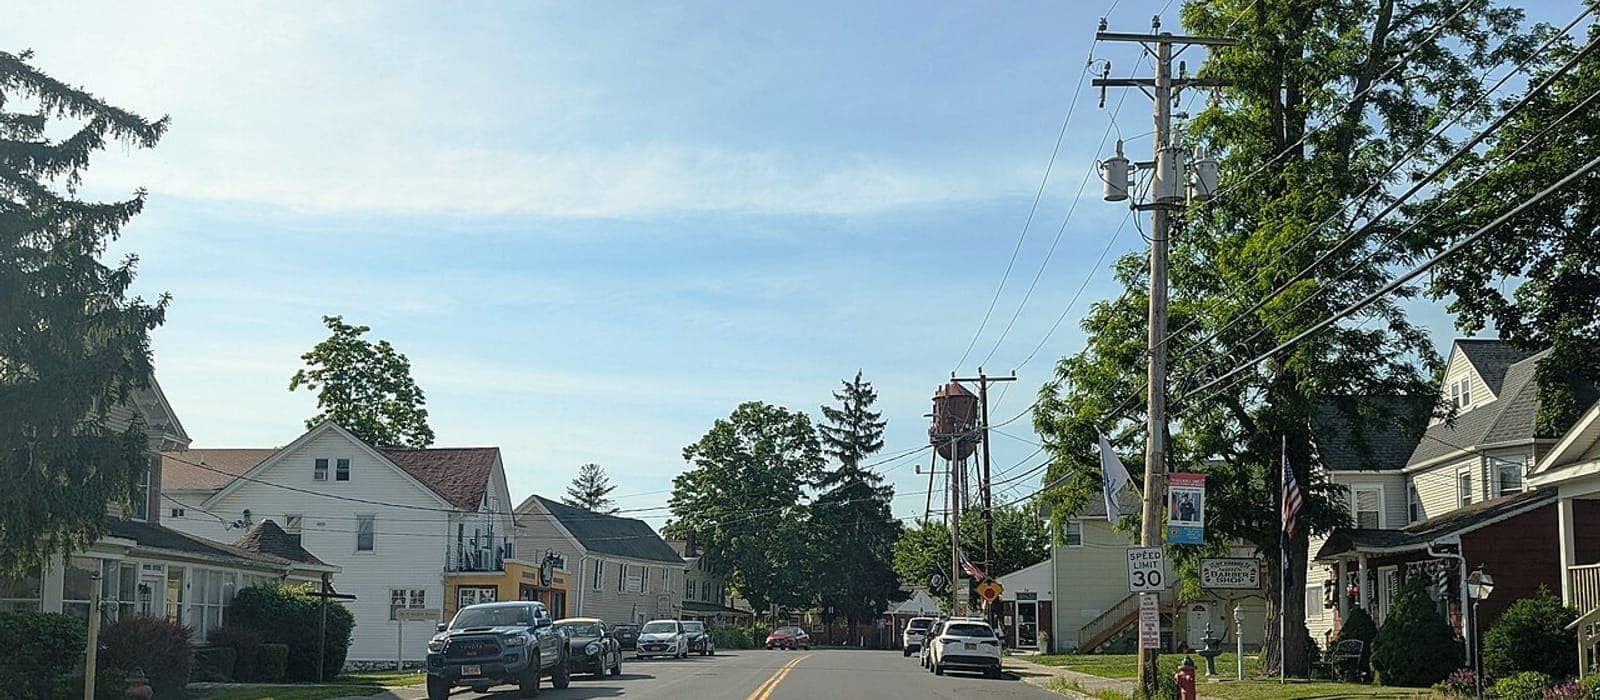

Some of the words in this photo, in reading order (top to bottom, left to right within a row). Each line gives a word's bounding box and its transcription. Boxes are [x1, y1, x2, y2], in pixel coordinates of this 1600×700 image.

[1130, 551, 1161, 560] SPEED
[1133, 561, 1158, 569] LIMIT
[1210, 570, 1249, 578] BARBER
[1132, 570, 1161, 587] 30
